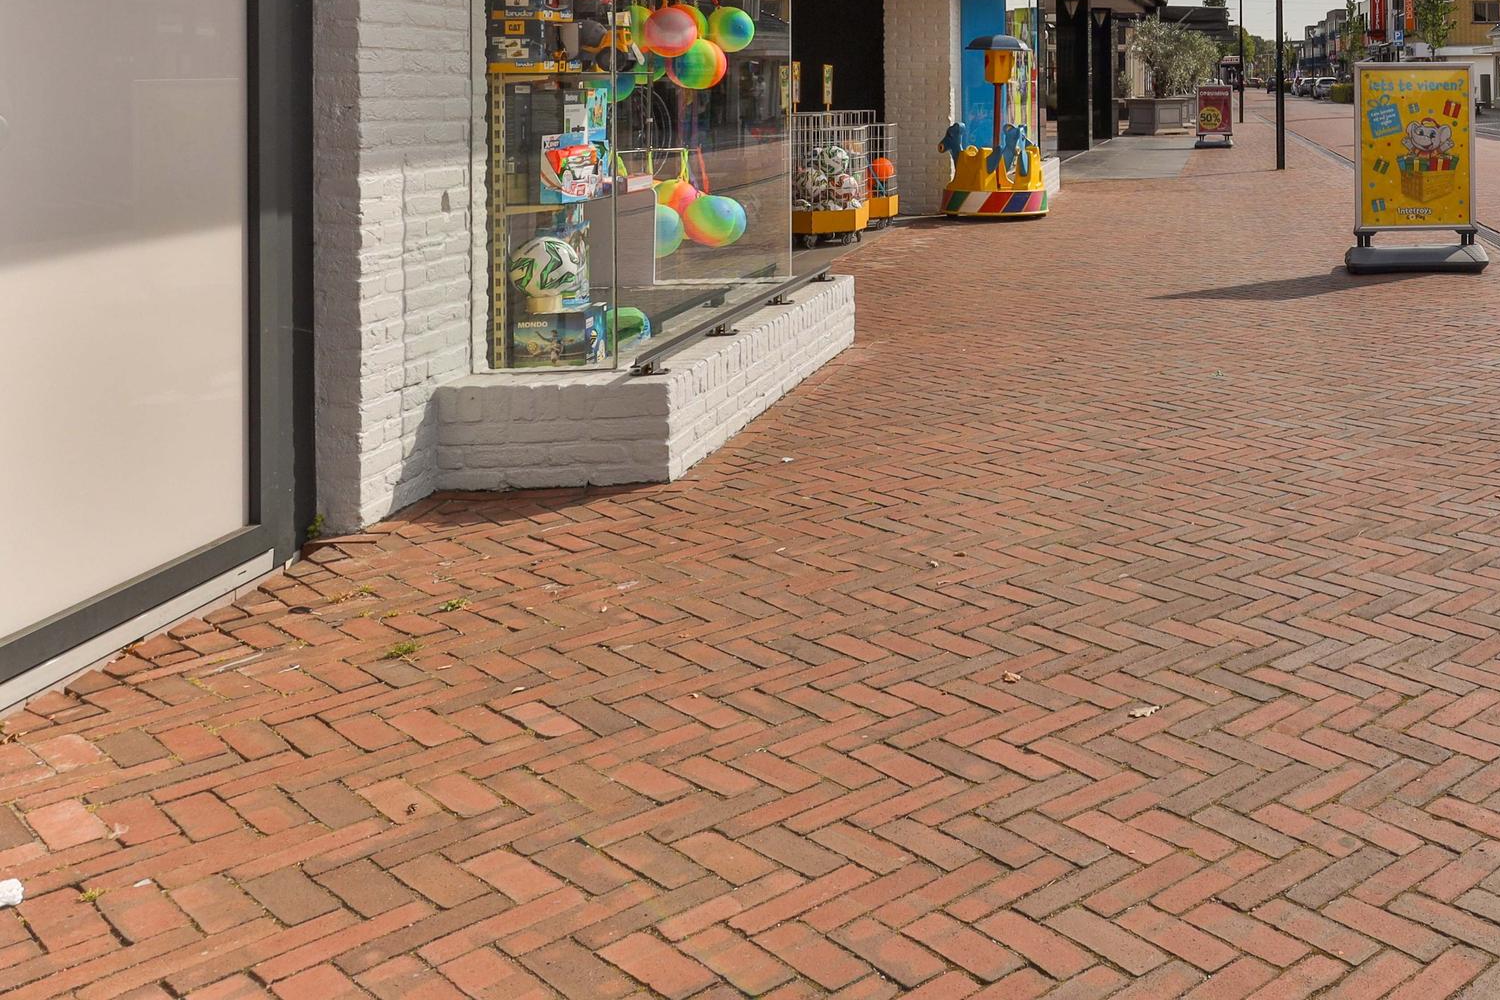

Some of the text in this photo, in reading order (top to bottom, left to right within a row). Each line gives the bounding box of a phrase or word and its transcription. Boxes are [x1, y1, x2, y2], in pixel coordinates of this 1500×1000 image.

[505, 10, 534, 18] bruder
[1398, 79, 1413, 92] te
[1418, 79, 1465, 92] vieren?
[1200, 113, 1221, 123] 50%
[1397, 207, 1432, 216] Intertoys
[517, 320, 549, 329] MONDO
